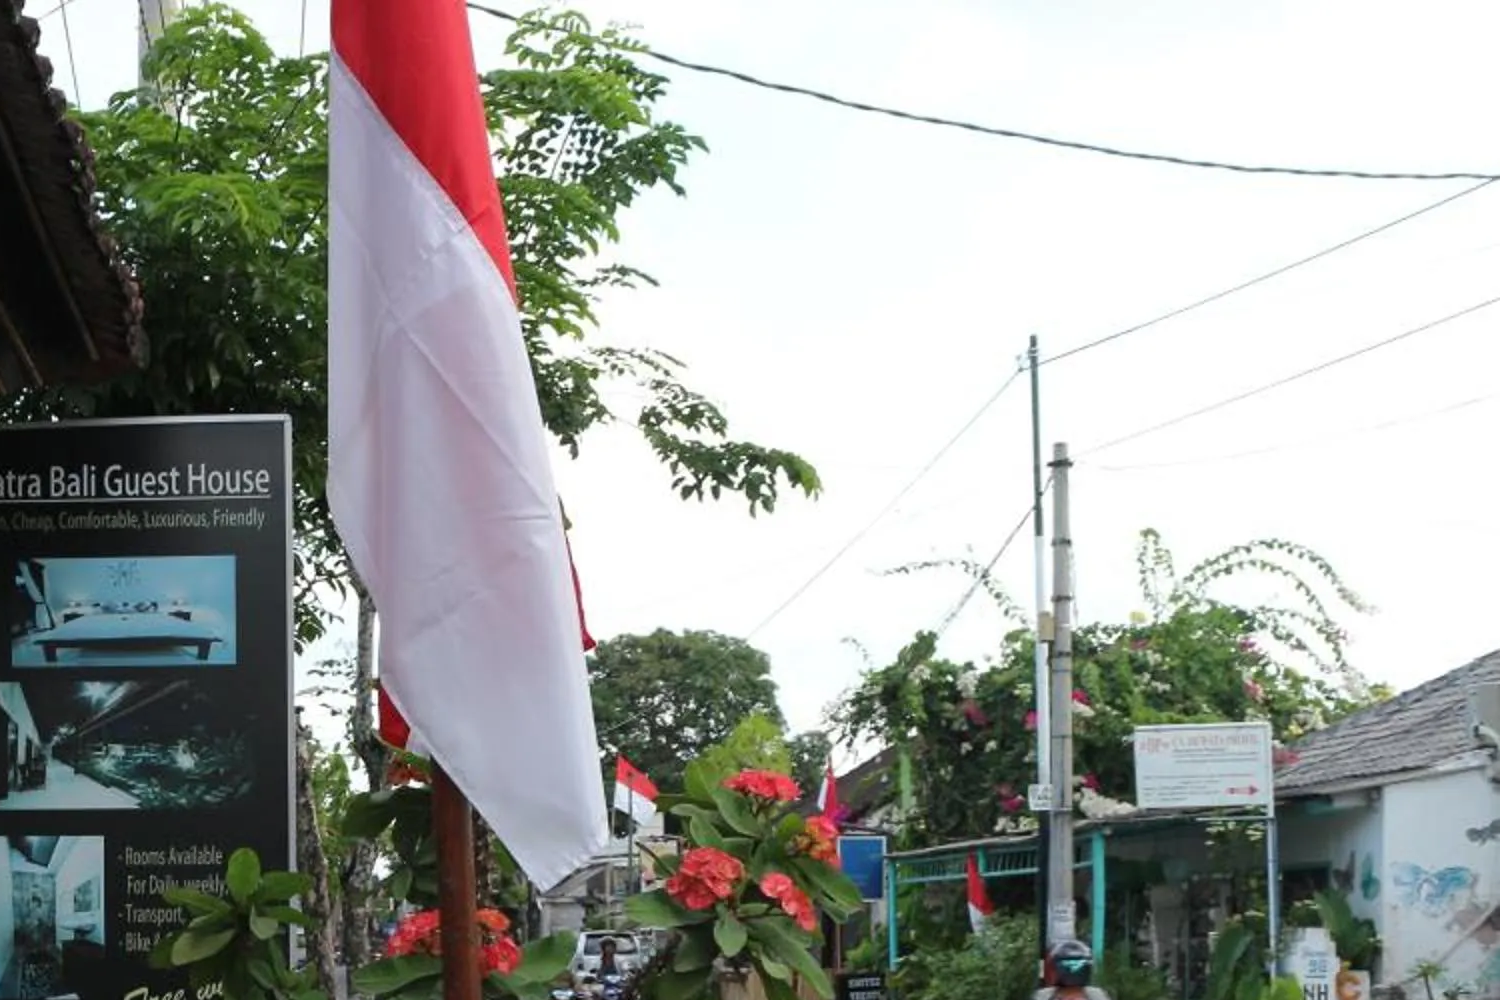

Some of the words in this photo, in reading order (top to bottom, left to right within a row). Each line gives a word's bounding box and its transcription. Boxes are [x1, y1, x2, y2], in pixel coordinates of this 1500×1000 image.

[50, 465, 97, 497] Bali
[103, 464, 181, 496] Guest
[187, 463, 270, 495] House
[58, 509, 141, 532] Comfortable,
[143, 508, 211, 531] Luxurious,
[212, 507, 265, 532] Friendly
[125, 847, 166, 866] Rooms
[168, 845, 223, 865] Available
[127, 874, 146, 895] For
[125, 931, 151, 952] Bike
